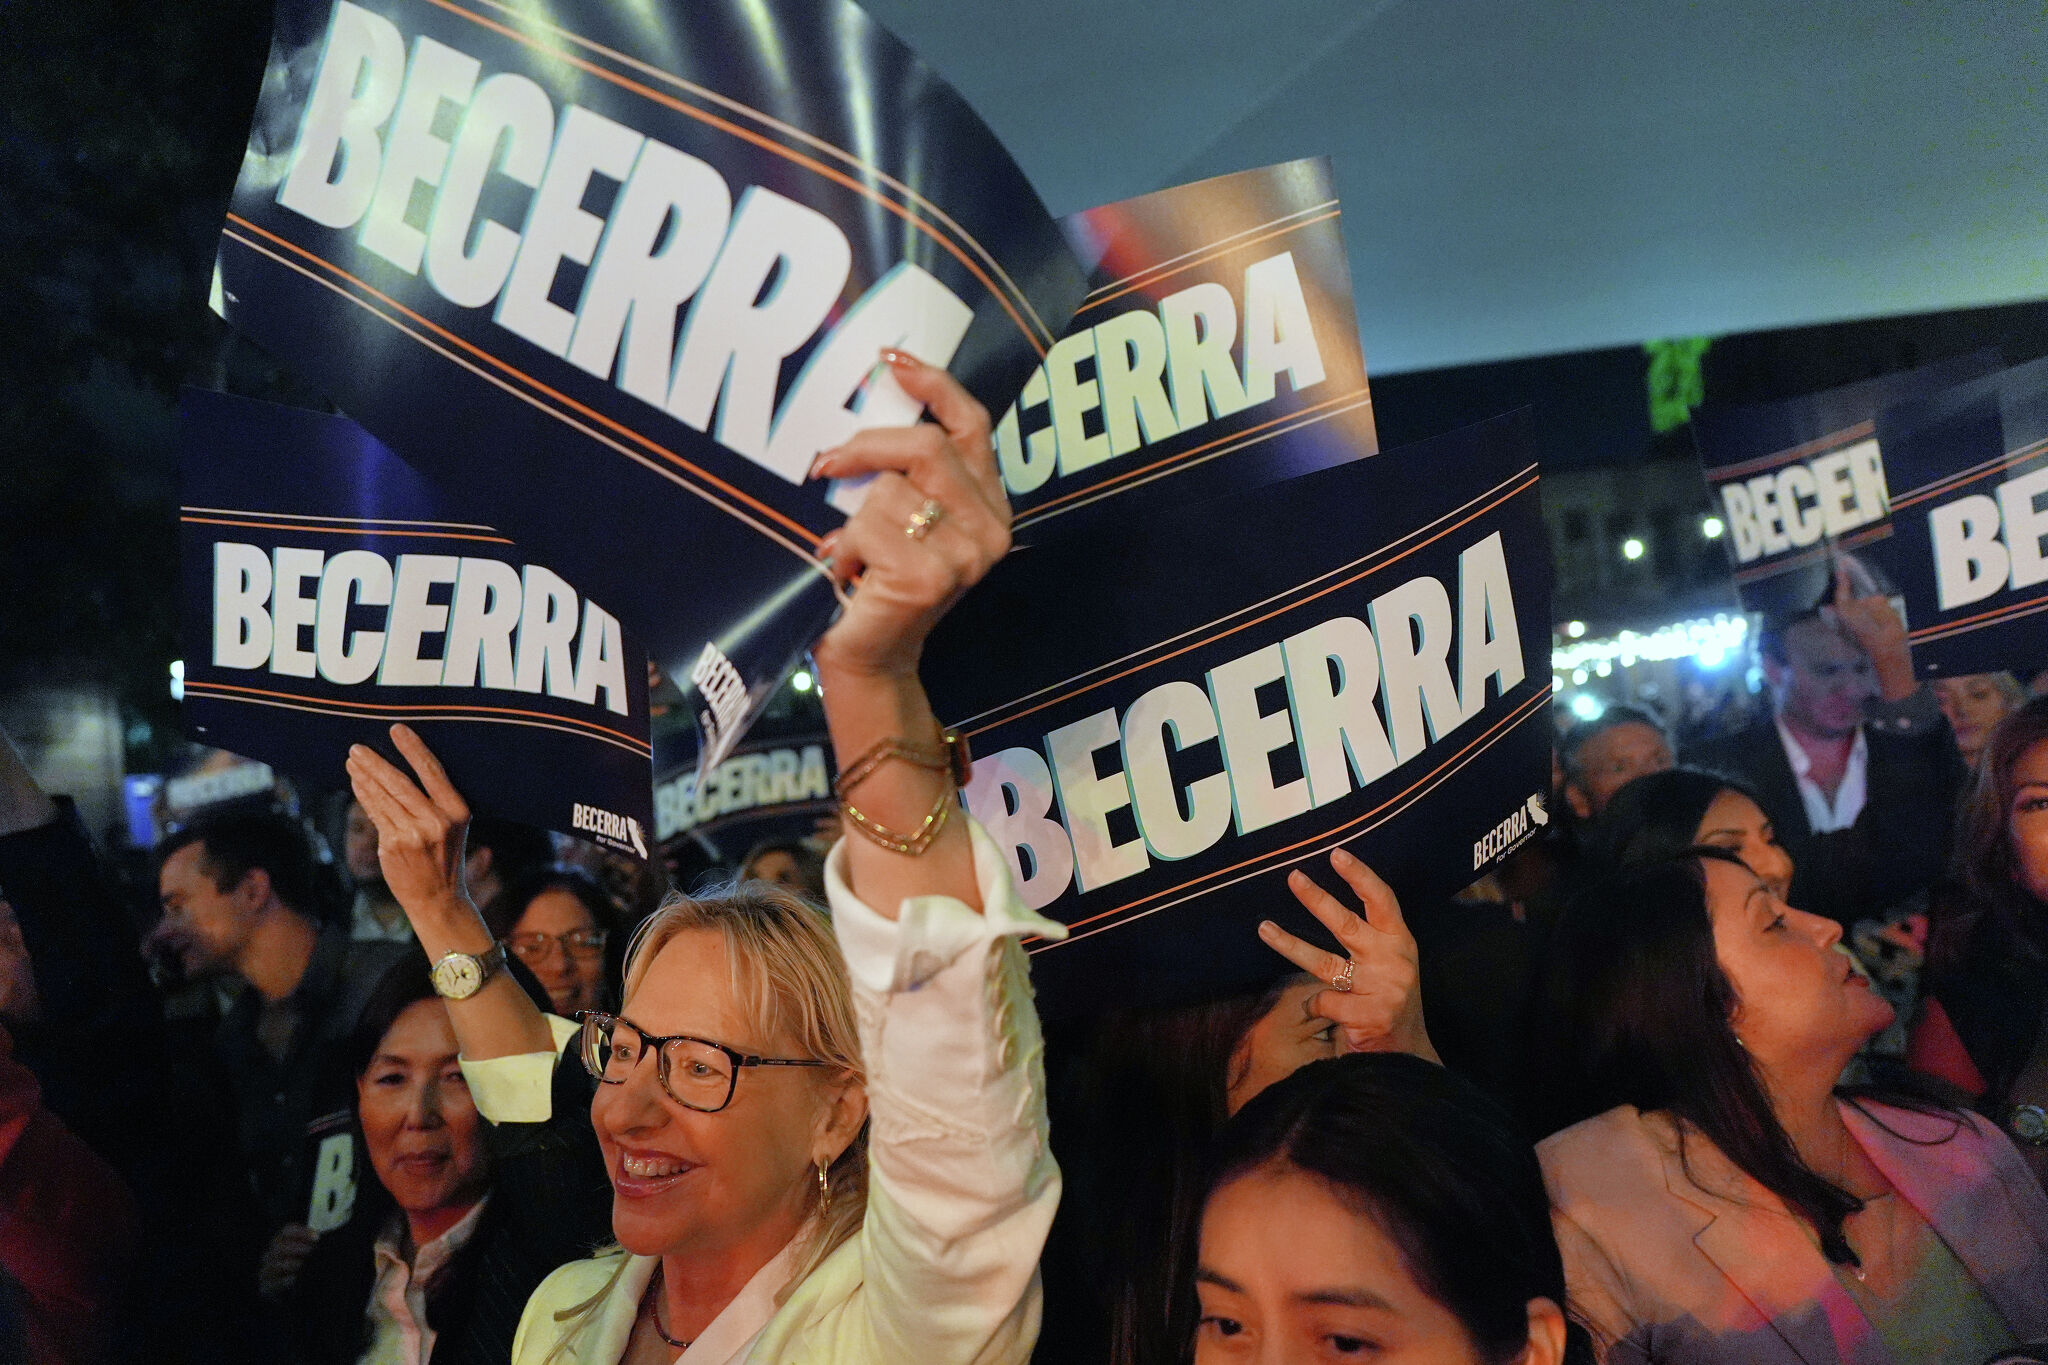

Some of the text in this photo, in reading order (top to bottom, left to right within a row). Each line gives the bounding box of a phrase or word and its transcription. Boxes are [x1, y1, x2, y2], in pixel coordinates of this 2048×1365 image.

[275, 0, 975, 518] BECERRA
[990, 251, 1326, 496] CERRA
[211, 541, 629, 717] BECERRA
[655, 745, 830, 843] BECERRA
[958, 530, 1526, 911] BECERRA
[572, 802, 628, 843] BECERRA
[1473, 804, 1528, 872] BECERRA
